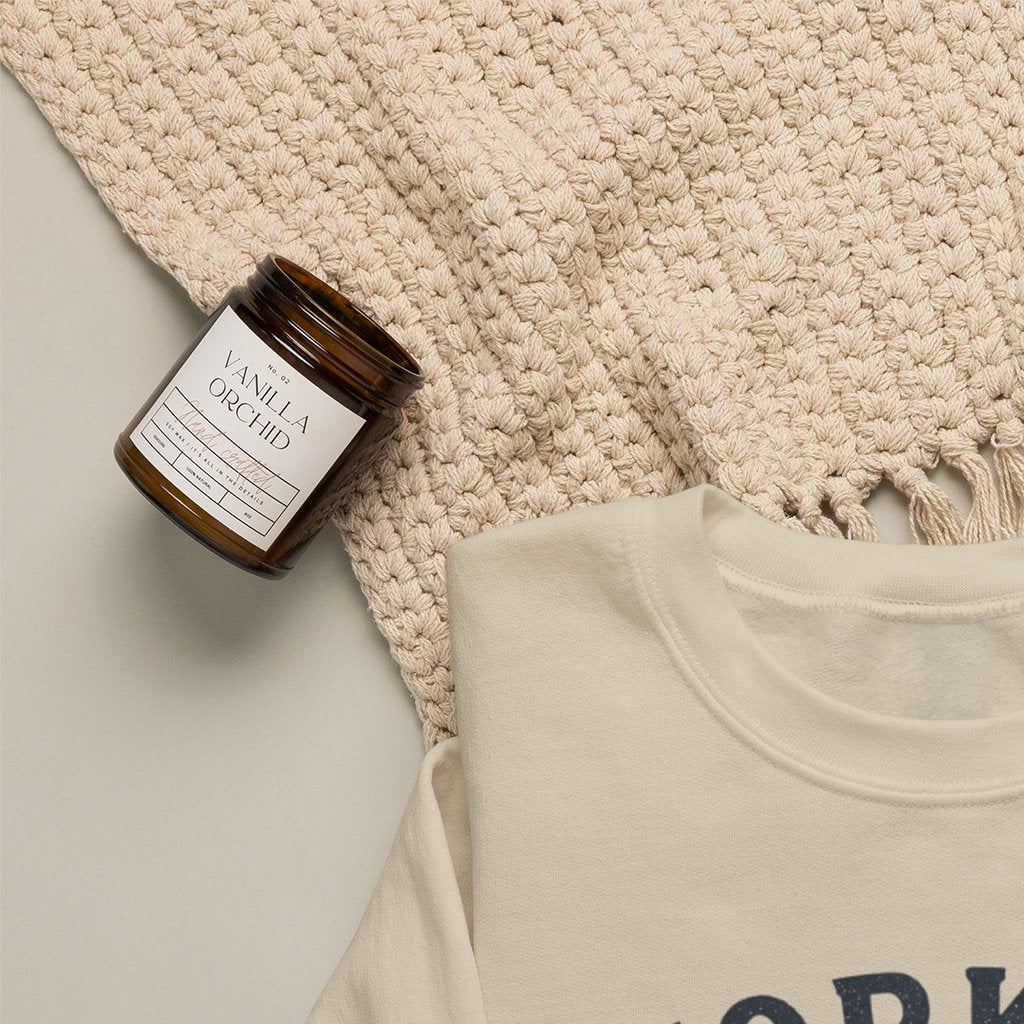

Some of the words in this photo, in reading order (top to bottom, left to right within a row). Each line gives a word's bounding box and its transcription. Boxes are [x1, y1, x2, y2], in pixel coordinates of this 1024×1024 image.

[224, 349, 309, 434] VANILLA
[266, 363, 278, 377] No.
[280, 375, 291, 385] 02
[208, 377, 291, 450] ORCHID
[203, 458, 214, 468] ALL
[225, 475, 237, 486] THE
[238, 485, 264, 505] DETAILS
